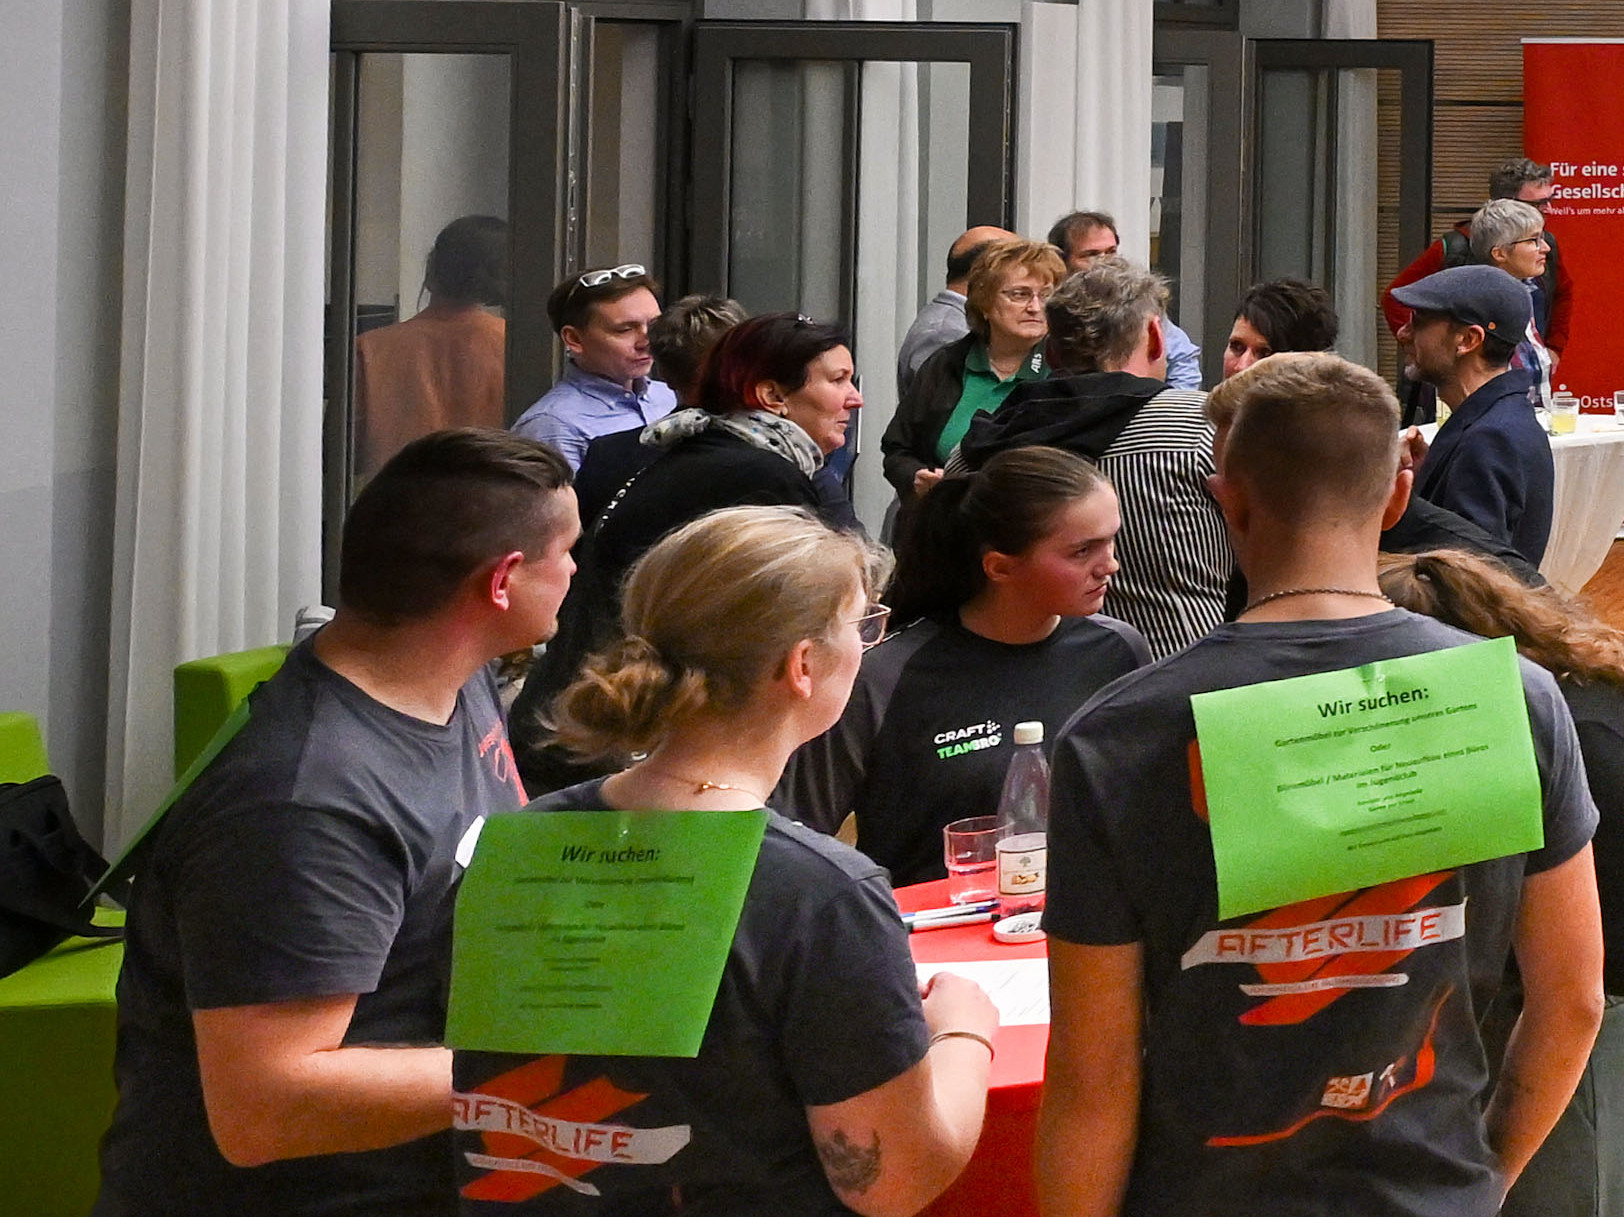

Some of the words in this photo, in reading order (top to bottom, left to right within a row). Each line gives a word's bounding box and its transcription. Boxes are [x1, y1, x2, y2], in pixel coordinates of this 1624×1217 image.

[1550, 162, 1577, 177] Für
[1581, 161, 1618, 177] eine
[1593, 207, 1616, 215] mehr
[1580, 395, 1613, 408] Osts
[1317, 701, 1352, 718] Wir
[1358, 687, 1430, 711] suchen:
[934, 724, 986, 744] CRAFT
[1369, 743, 1391, 753] Oder
[561, 845, 595, 862] Wir
[1216, 912, 1442, 957] AFTERLIFE
[453, 1097, 634, 1159] AFTERLIFE
